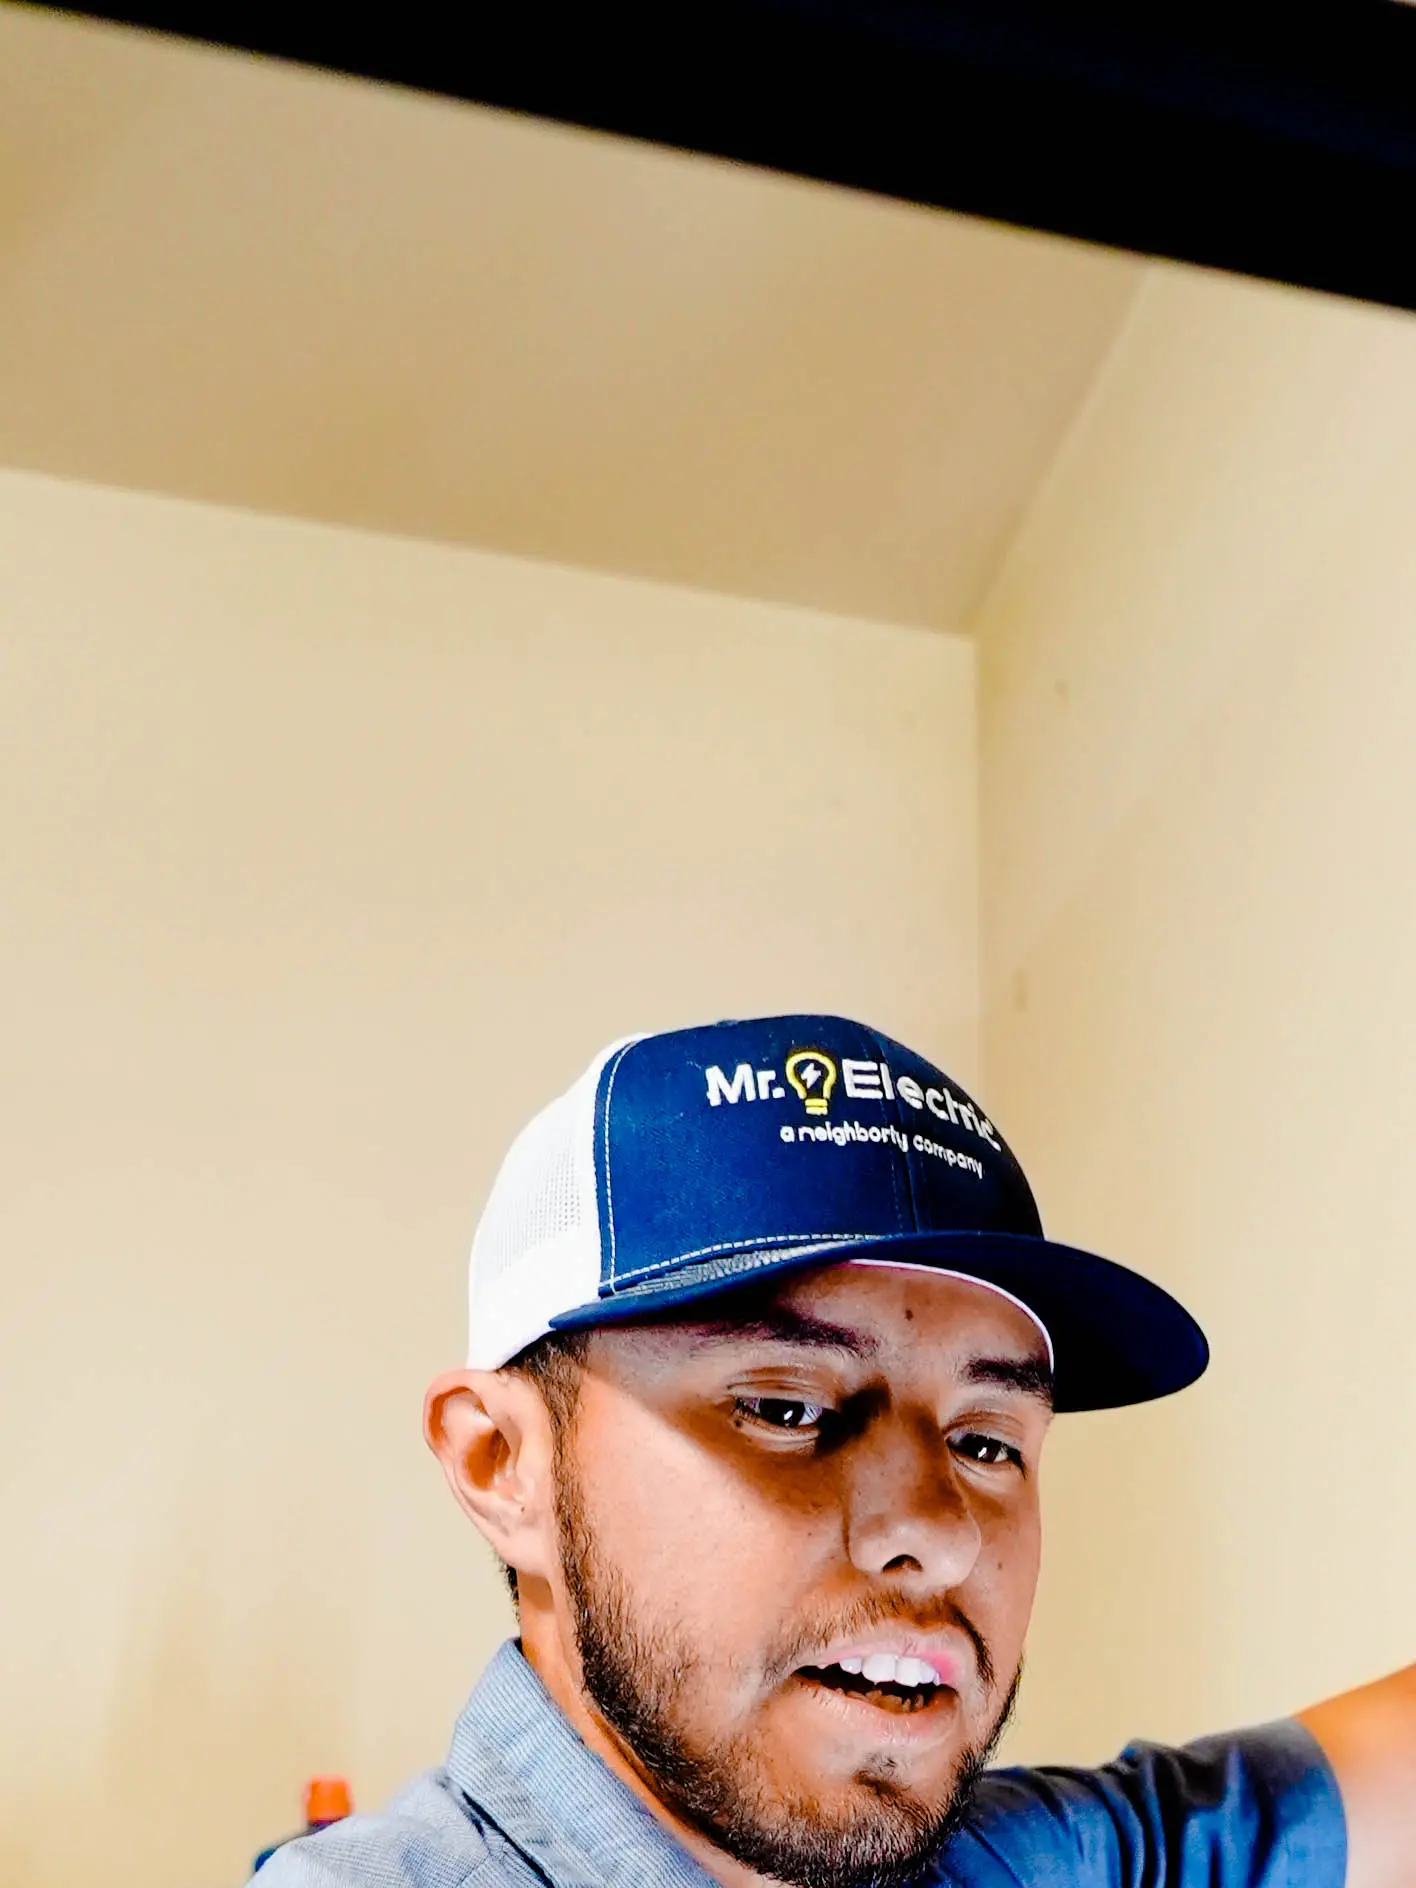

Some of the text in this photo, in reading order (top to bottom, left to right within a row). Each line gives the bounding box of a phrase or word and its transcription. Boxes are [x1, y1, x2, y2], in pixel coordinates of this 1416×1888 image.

[705, 1058, 1001, 1151] Mr. Electric
[780, 1121, 984, 1180] a neighborly company
